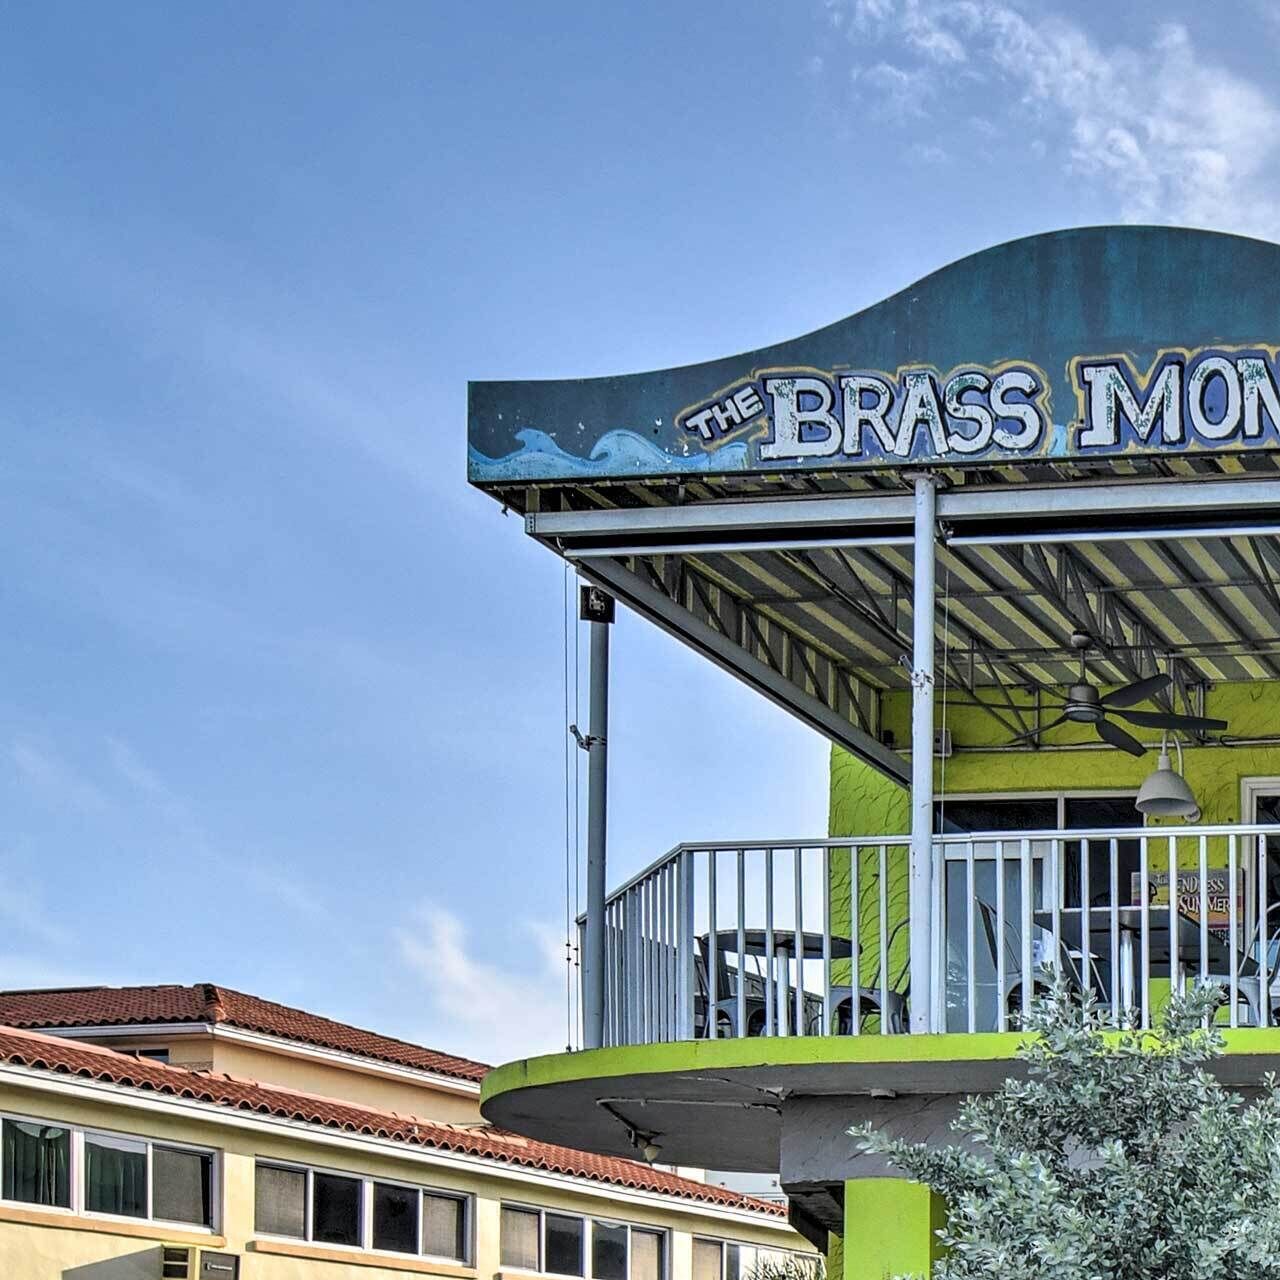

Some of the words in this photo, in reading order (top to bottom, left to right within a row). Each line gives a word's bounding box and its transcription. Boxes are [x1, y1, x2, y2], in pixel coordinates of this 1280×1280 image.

[686, 386, 764, 440] THE
[759, 371, 1043, 461] BRASS
[1176, 876, 1225, 895] ENDESS
